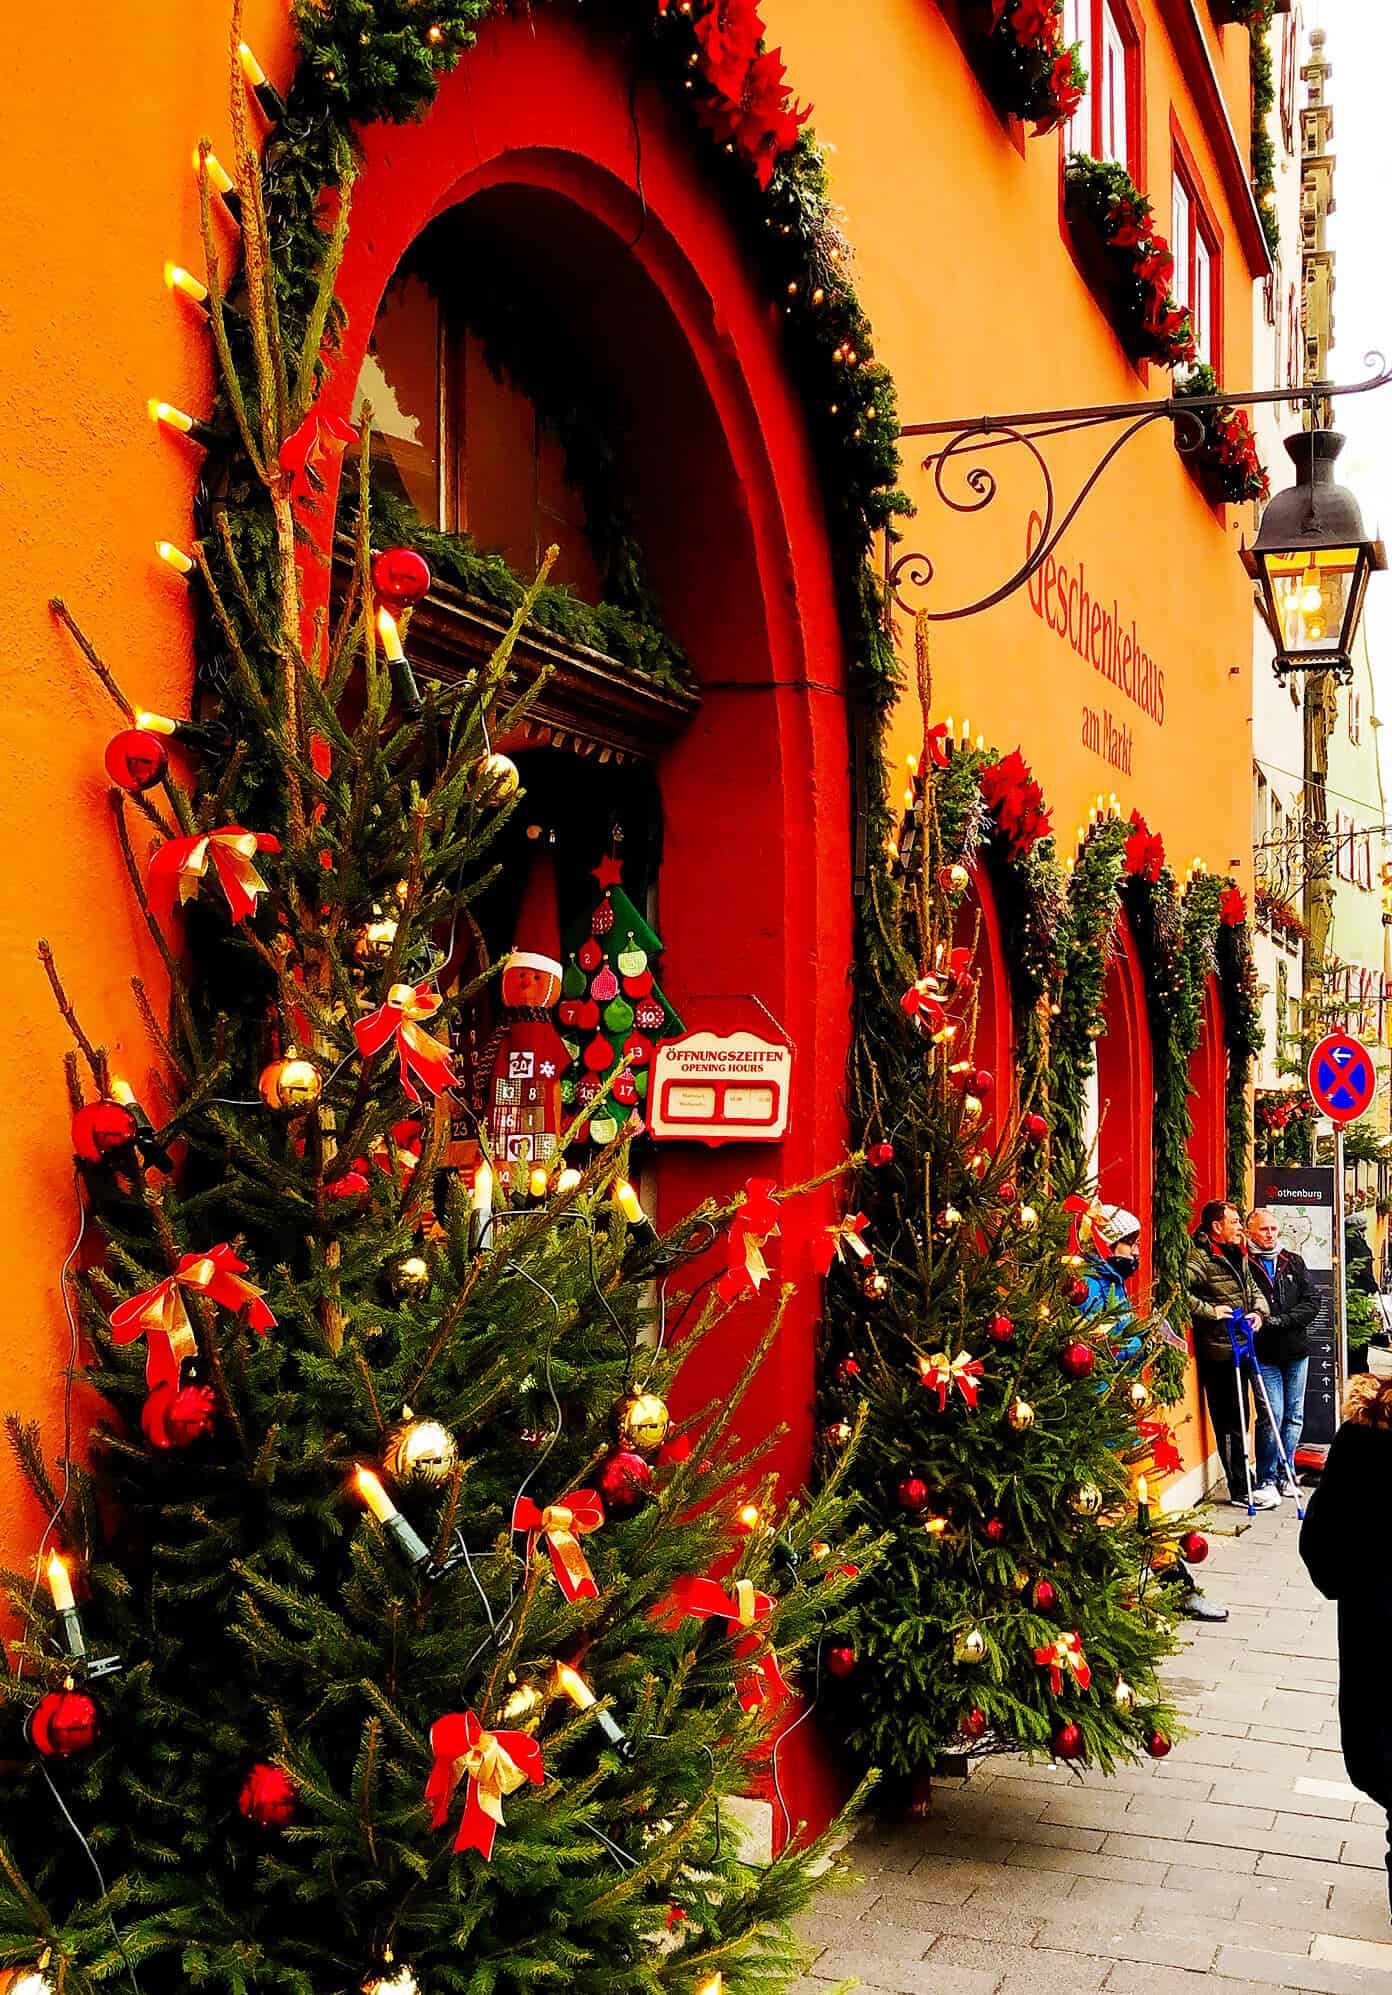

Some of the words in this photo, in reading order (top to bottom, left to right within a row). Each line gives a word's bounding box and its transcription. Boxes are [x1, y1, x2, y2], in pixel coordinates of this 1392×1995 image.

[1026, 510, 1165, 727] Geschenkehaus
[1081, 705, 1100, 757] am
[1103, 709, 1133, 777] Markt
[641, 1012, 655, 1022] 10
[630, 1046, 643, 1058] 13
[666, 1048, 783, 1062] ÖFFNUNGSZEITEN
[681, 1063, 726, 1073] OPENING
[728, 1064, 764, 1073] HOURS
[528, 1087, 537, 1100] 8
[620, 1085, 634, 1097] 17
[501, 1113, 513, 1127] 16
[453, 1122, 468, 1137] 23
